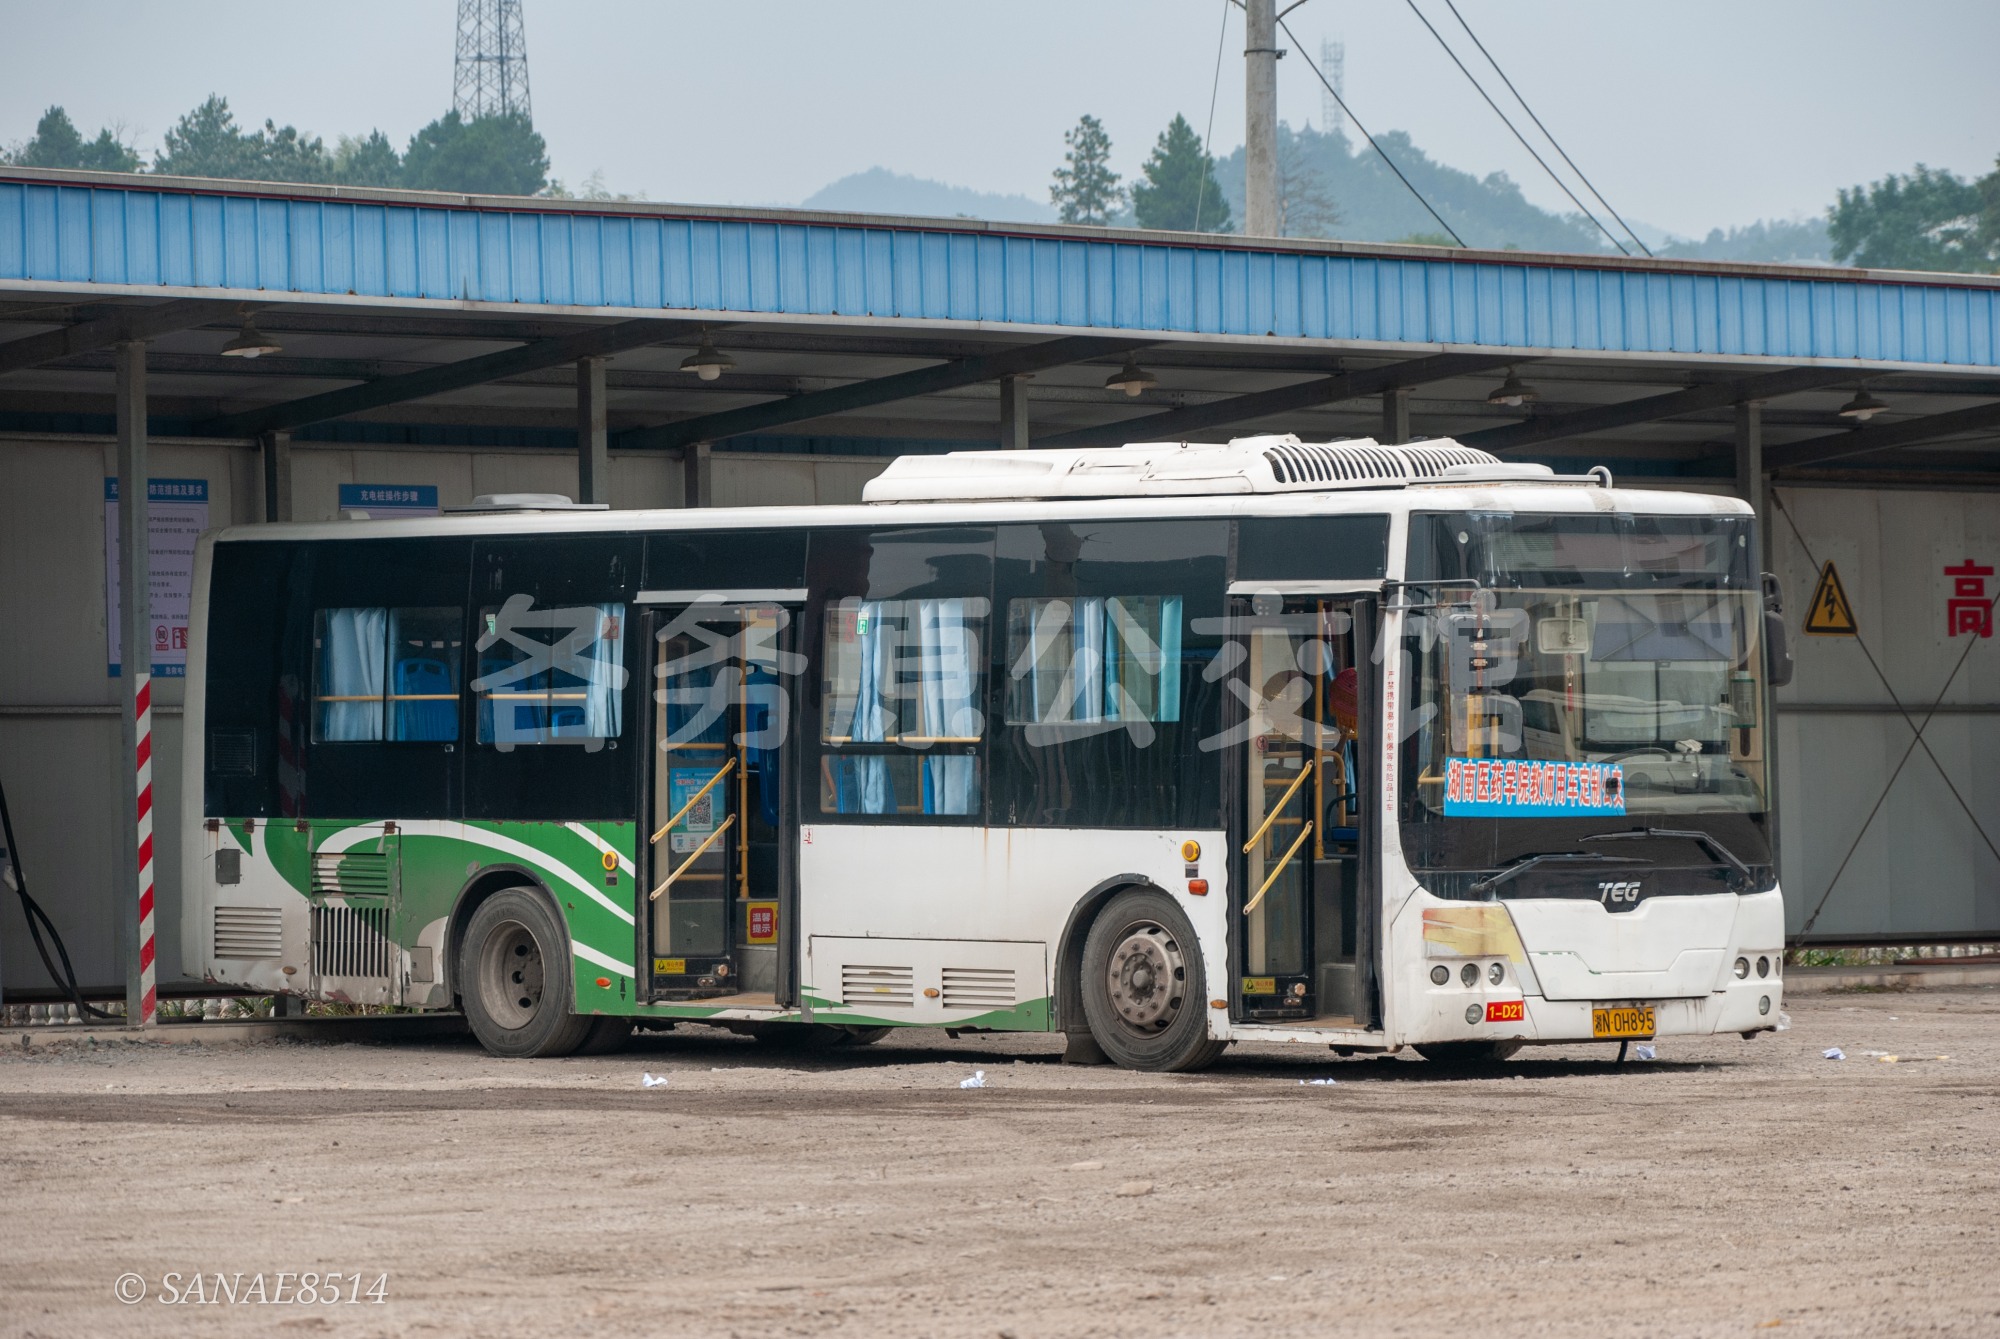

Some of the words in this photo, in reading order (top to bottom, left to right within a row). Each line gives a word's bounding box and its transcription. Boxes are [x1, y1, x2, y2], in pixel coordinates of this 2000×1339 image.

[361, 489, 418, 502] 充电桩操作步骤
[1944, 559, 1994, 638] 高
[1598, 881, 1641, 903] TEG
[752, 912, 771, 922] 温馨
[752, 923, 771, 933] 提示
[1488, 1004, 1523, 1019] 1-D21
